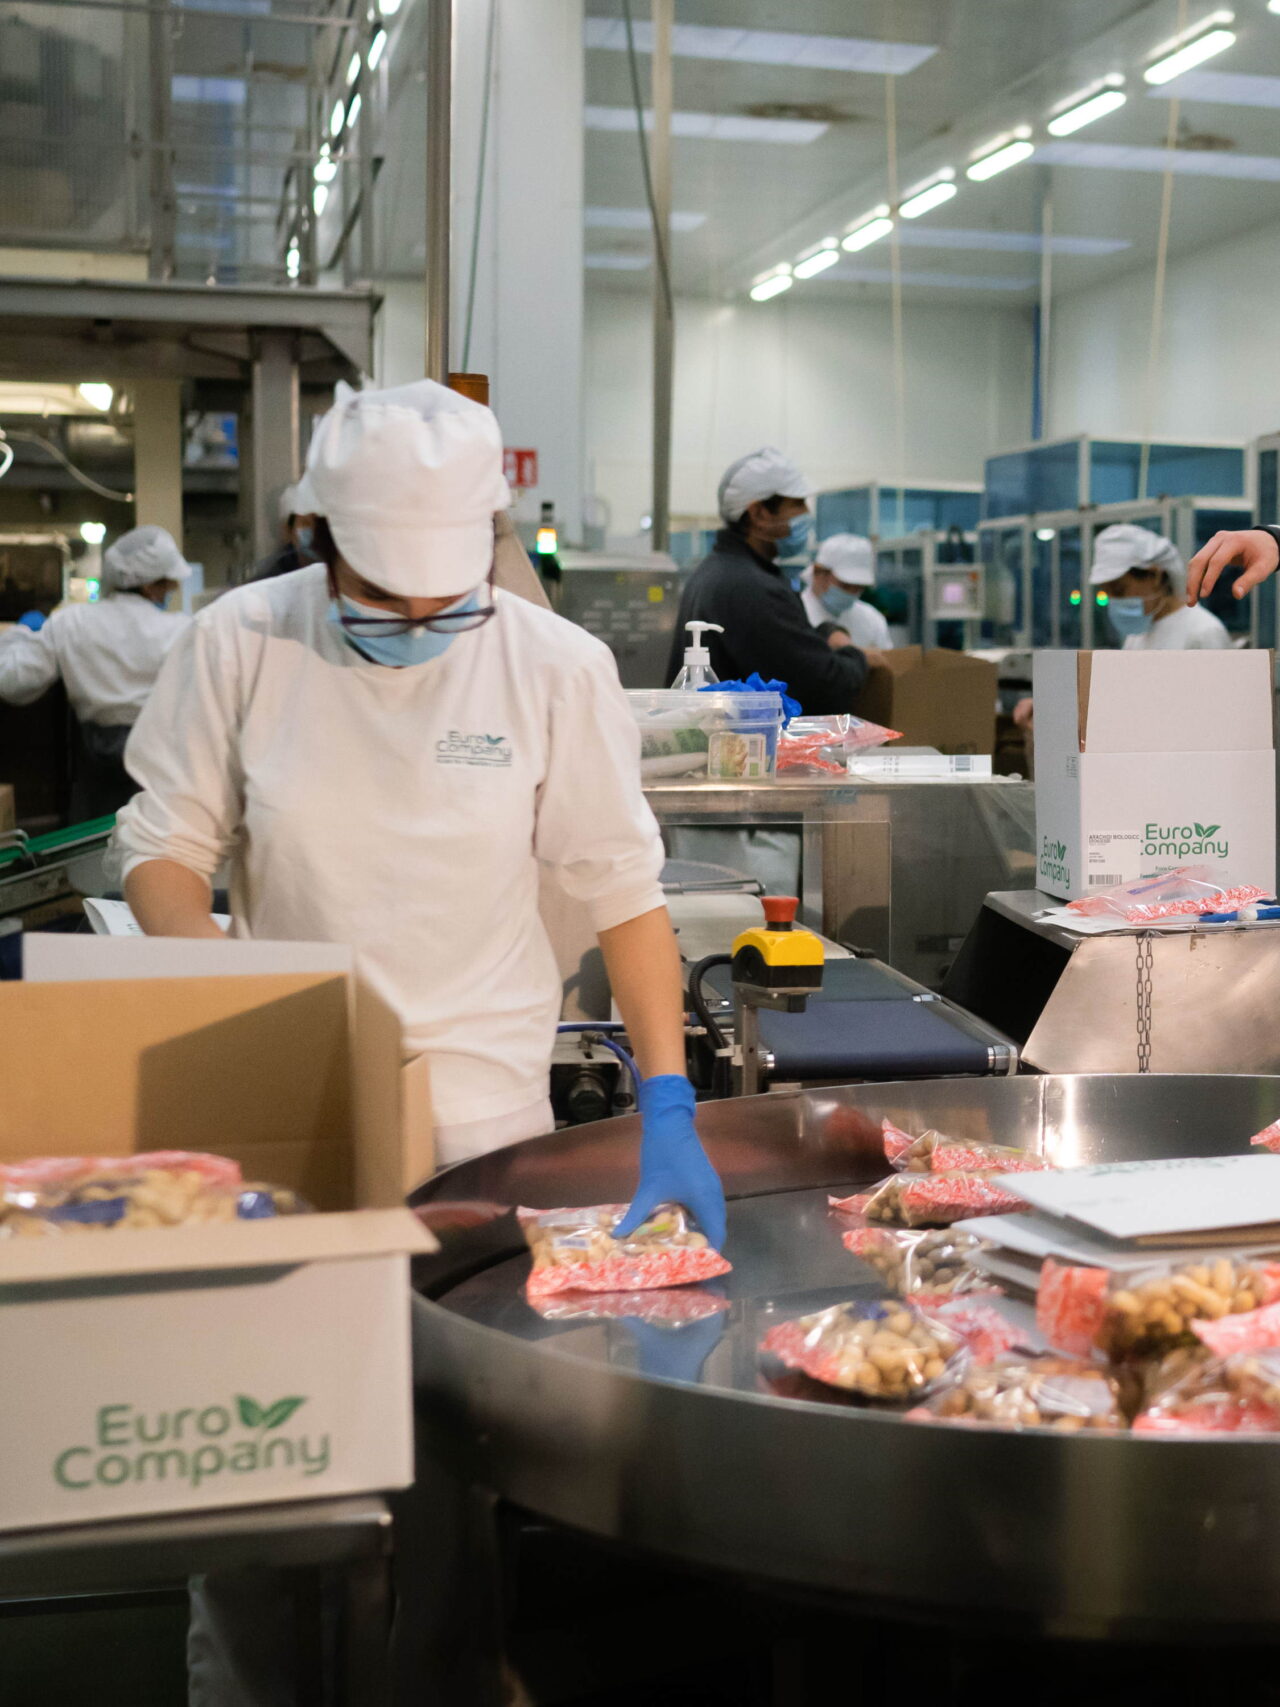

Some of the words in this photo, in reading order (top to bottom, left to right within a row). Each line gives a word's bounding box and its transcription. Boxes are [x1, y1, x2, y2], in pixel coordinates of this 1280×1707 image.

[448, 730, 486, 744] Euro
[436, 740, 512, 760] Company
[1145, 823, 1193, 840] Euro
[1043, 835, 1058, 860] Euro
[1140, 840, 1229, 860] ompany
[1040, 854, 1070, 890] Company
[96, 1403, 231, 1447] Euro
[53, 1433, 331, 1490] Company
